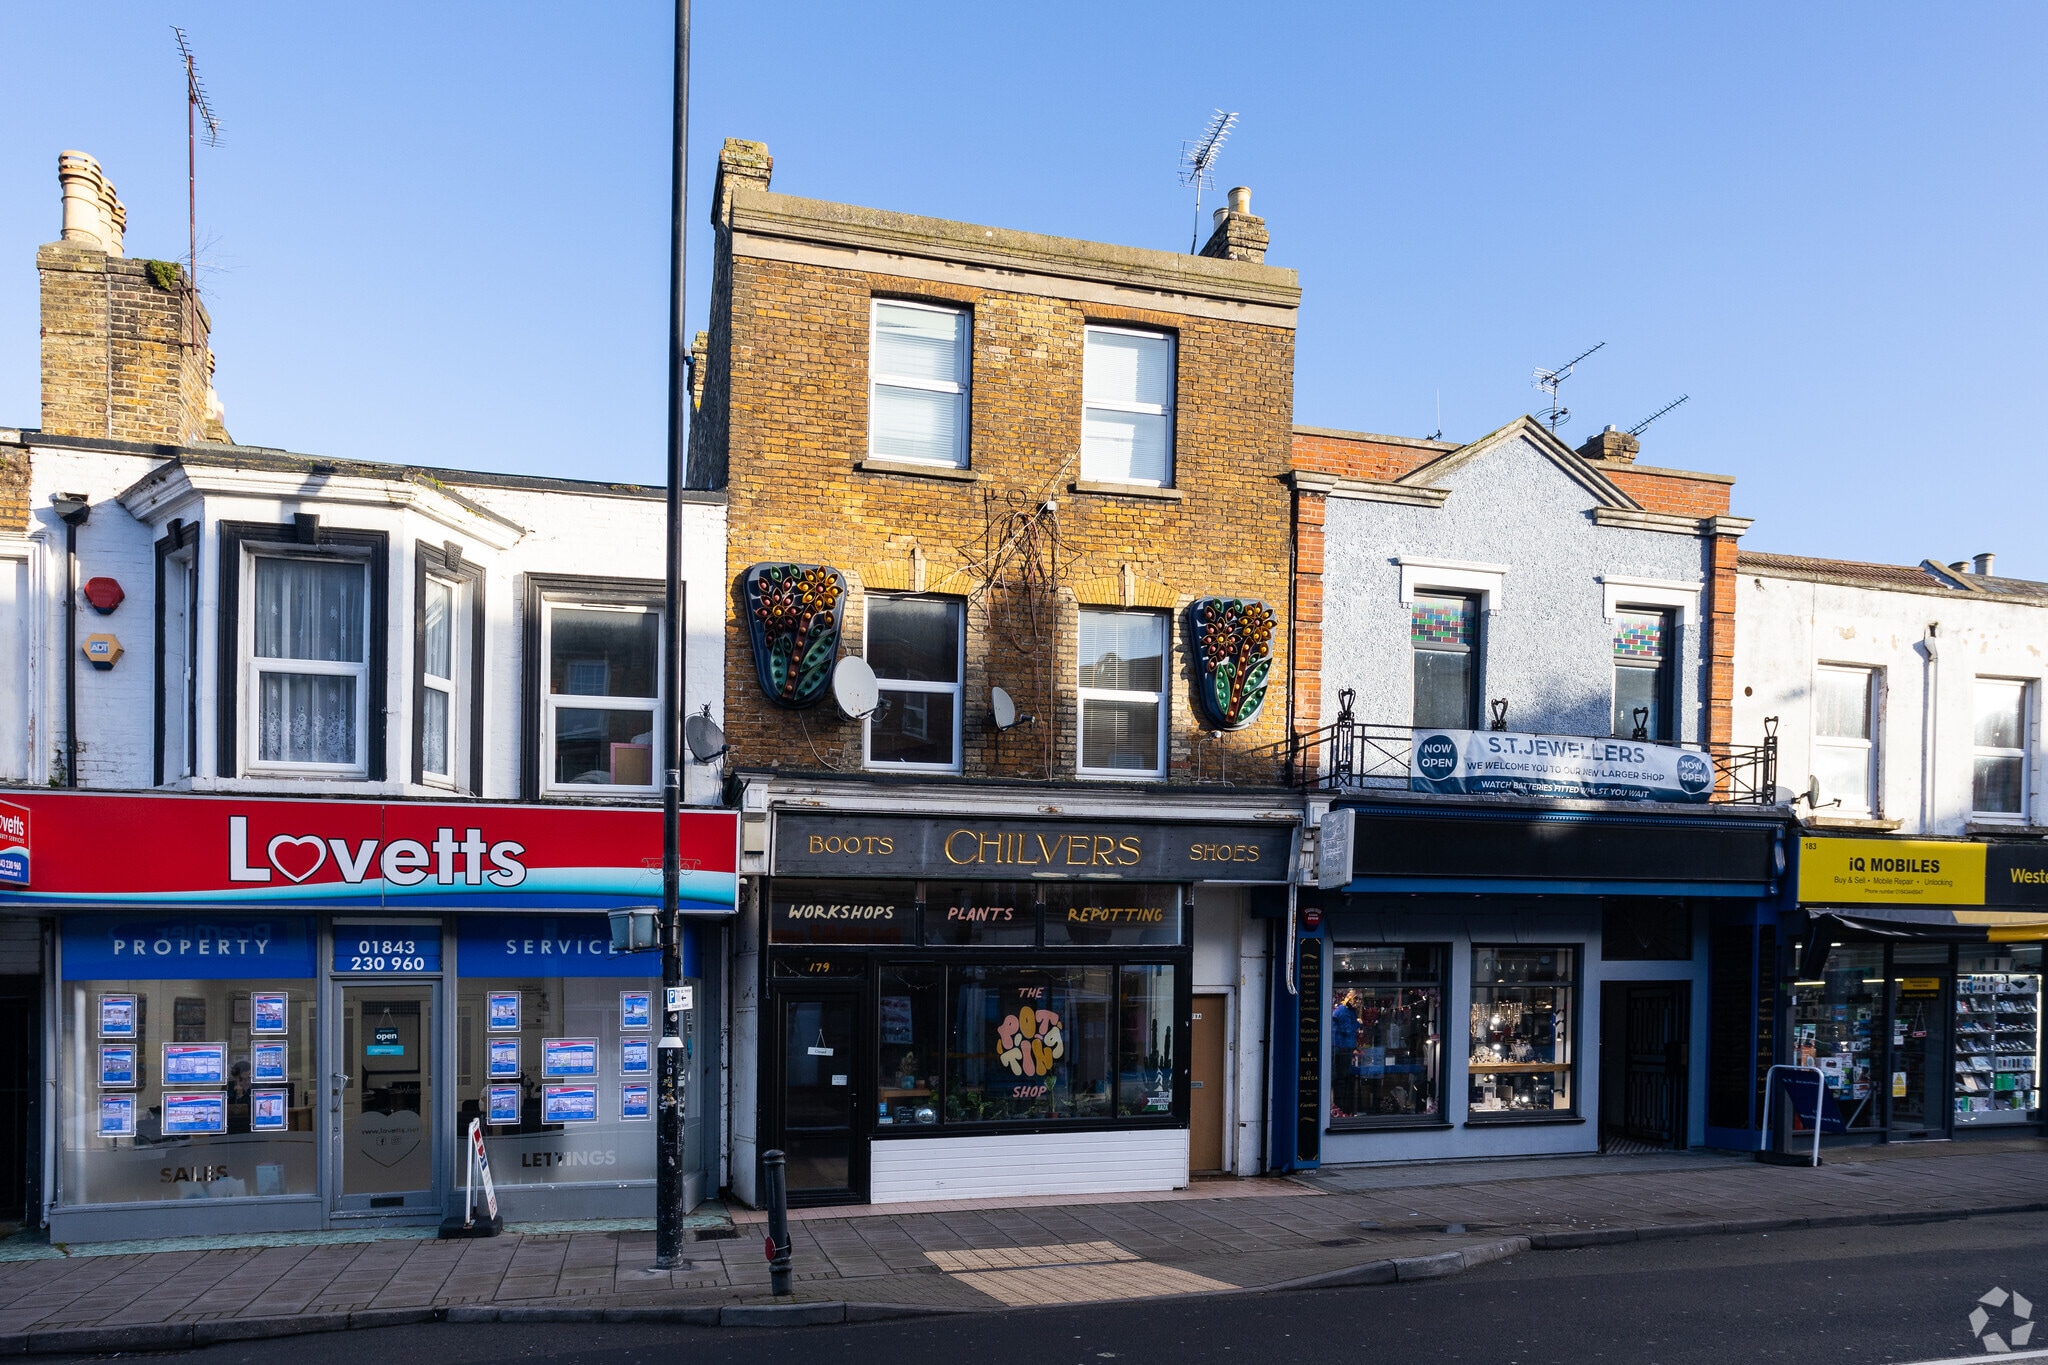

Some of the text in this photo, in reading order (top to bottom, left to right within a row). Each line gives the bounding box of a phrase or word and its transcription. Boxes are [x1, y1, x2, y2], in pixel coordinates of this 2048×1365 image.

[90, 643, 108, 652] ADT
[1424, 743, 1452, 754] NOW
[1421, 758, 1453, 768] OPEN
[1681, 760, 1702, 770] NOW
[1466, 761, 1482, 770] WE
[1484, 762, 1530, 772] WELCOME
[1531, 764, 1548, 773] YOU
[1550, 765, 1562, 774] TO
[1564, 766, 1581, 776] OUR
[1602, 769, 1640, 780] LARGER
[1642, 772, 1665, 782] SHOP
[1681, 772, 1707, 783] OPEN
[1481, 780, 1512, 789] WATCH
[1513, 782, 1553, 792] BATTERIES
[1553, 785, 1580, 794] FITTED
[1610, 788, 1628, 797] YOU
[1628, 789, 1650, 798] WAIT
[808, 834, 894, 855] BOOTS
[944, 828, 1143, 866] CHILVERS
[1804, 842, 1817, 850] 183
[1188, 843, 1260, 862] SHOES
[1848, 857, 1940, 874] iQ MOBILES
[1834, 876, 1847, 886] Buy
[1873, 877, 1893, 885] Mobile
[1894, 878, 1914, 888] Repair
[1924, 878, 1953, 888] Unlocking
[2010, 867, 2048, 885] Weste
[788, 904, 895, 920] WORKSHOPS
[947, 906, 1014, 921] PLANTS
[1067, 906, 1163, 922] REPOTTING
[114, 939, 270, 955] PROPERTY
[358, 940, 416, 954] 01843
[506, 939, 633, 955] SERVICE
[351, 957, 425, 971] 230 960
[809, 962, 830, 973] 179
[1018, 987, 1044, 998] THE
[376, 1032, 398, 1041] open
[1012, 1086, 1048, 1098] SHOP
[522, 1149, 616, 1168] LETTINGS
[160, 1165, 229, 1184] SALES
